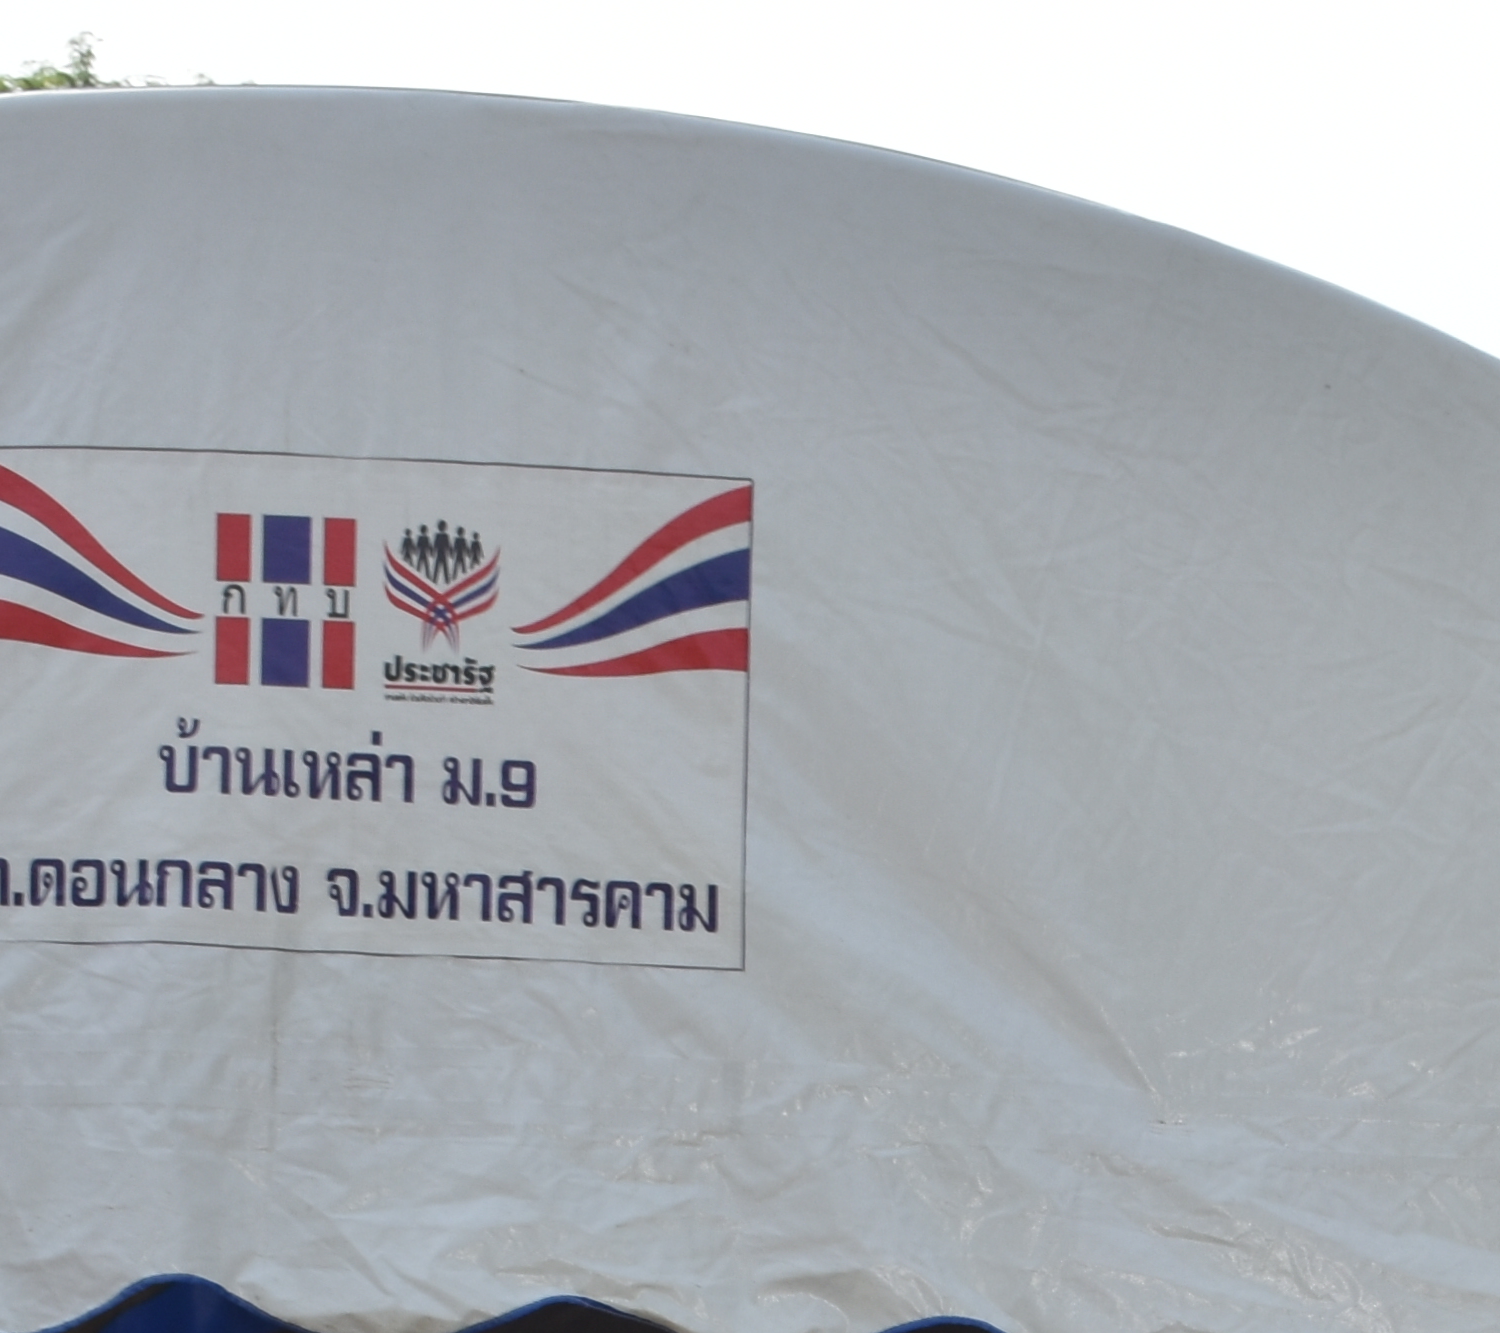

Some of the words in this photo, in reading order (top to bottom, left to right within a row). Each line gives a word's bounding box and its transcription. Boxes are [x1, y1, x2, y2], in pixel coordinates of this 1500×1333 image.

[384, 655, 495, 693] ประชารัฐ
[159, 717, 414, 802] บ้านเหล่า
[327, 868, 718, 933] จ.มหาสารคาม
